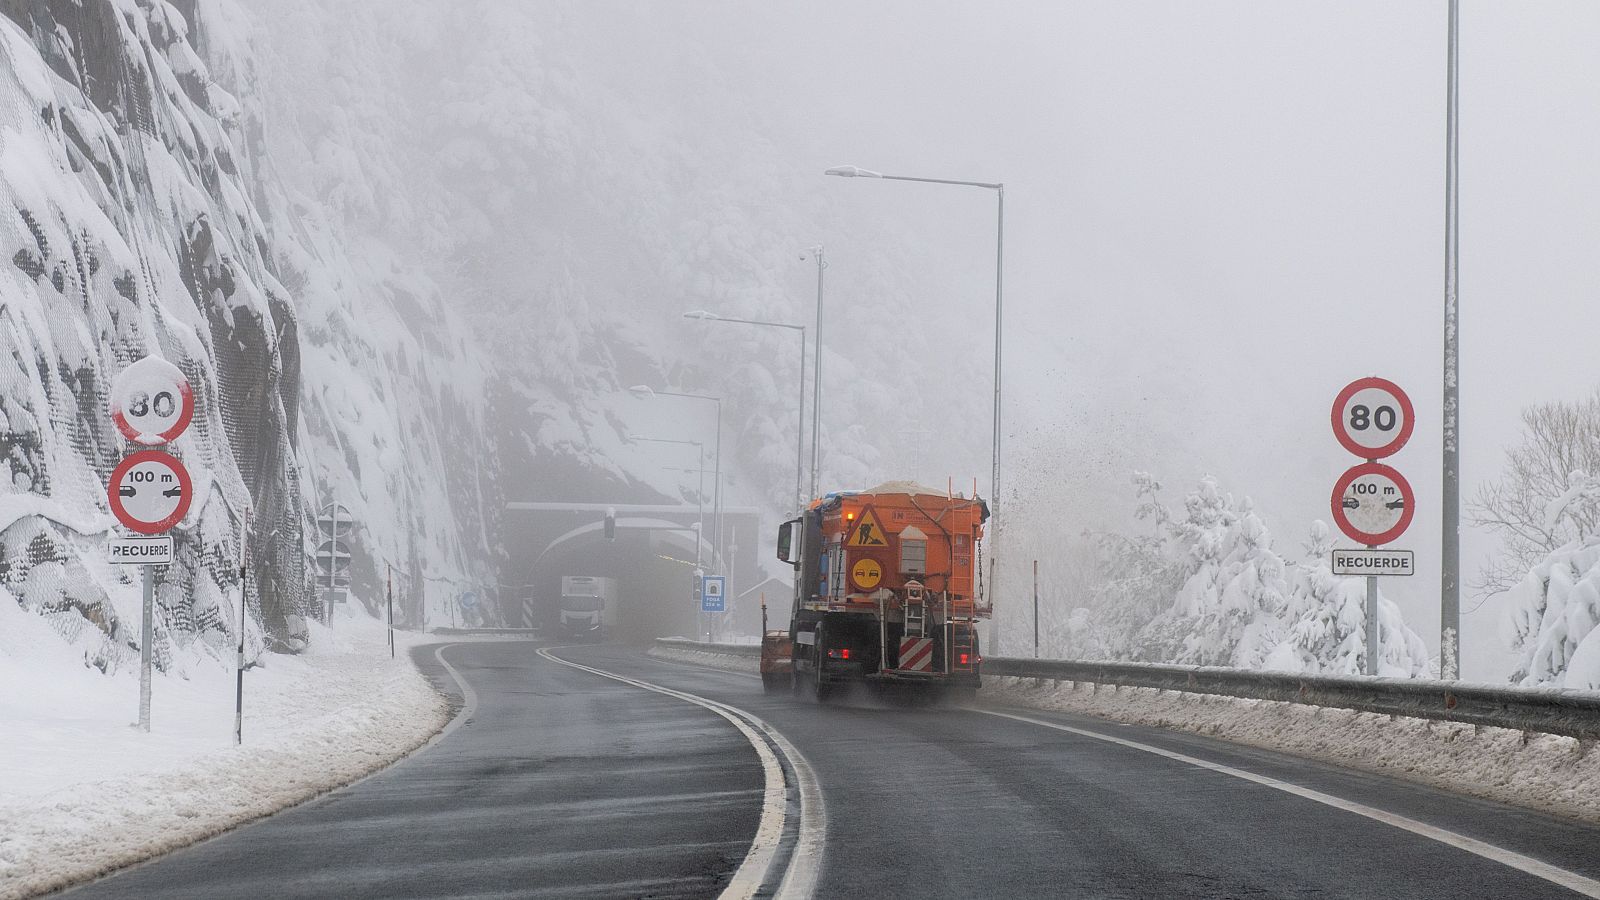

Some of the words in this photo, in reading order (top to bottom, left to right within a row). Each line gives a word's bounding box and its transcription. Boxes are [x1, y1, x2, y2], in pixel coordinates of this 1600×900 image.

[1350, 404, 1396, 431] 80
[128, 471, 155, 482] 100
[160, 474, 172, 482] m
[1351, 483, 1377, 495] 100
[1383, 486, 1395, 495] m
[113, 545, 168, 556] RECUERDE
[1337, 557, 1408, 568] RECUERDE
